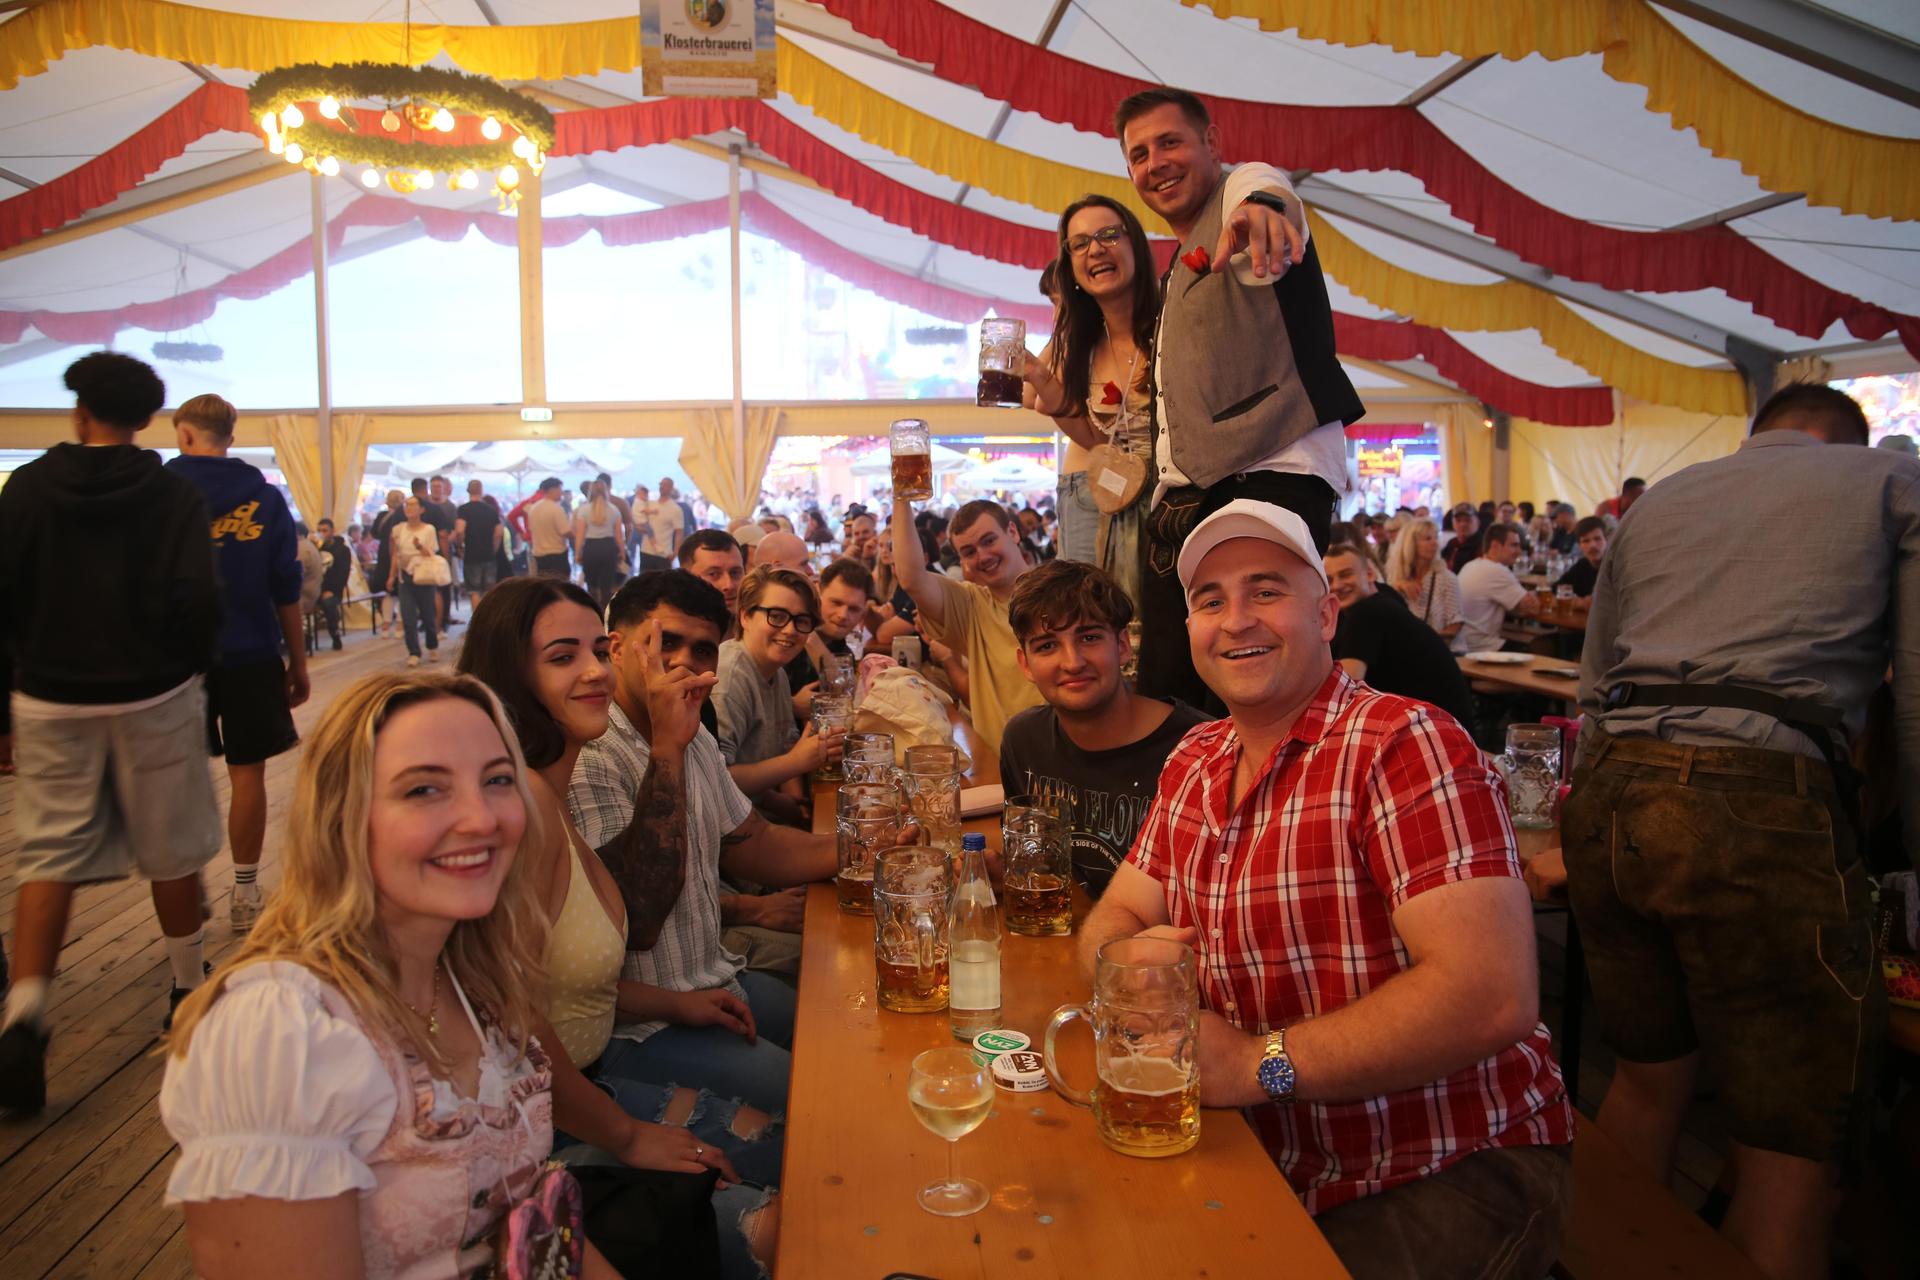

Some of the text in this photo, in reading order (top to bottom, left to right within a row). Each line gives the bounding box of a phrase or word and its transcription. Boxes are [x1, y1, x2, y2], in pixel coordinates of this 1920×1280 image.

[664, 33, 752, 50] Klosterbrauerei
[1084, 788, 1152, 848] FLOY
[1090, 842, 1098, 850] OF
[1021, 1054, 1040, 1070] NAZ
